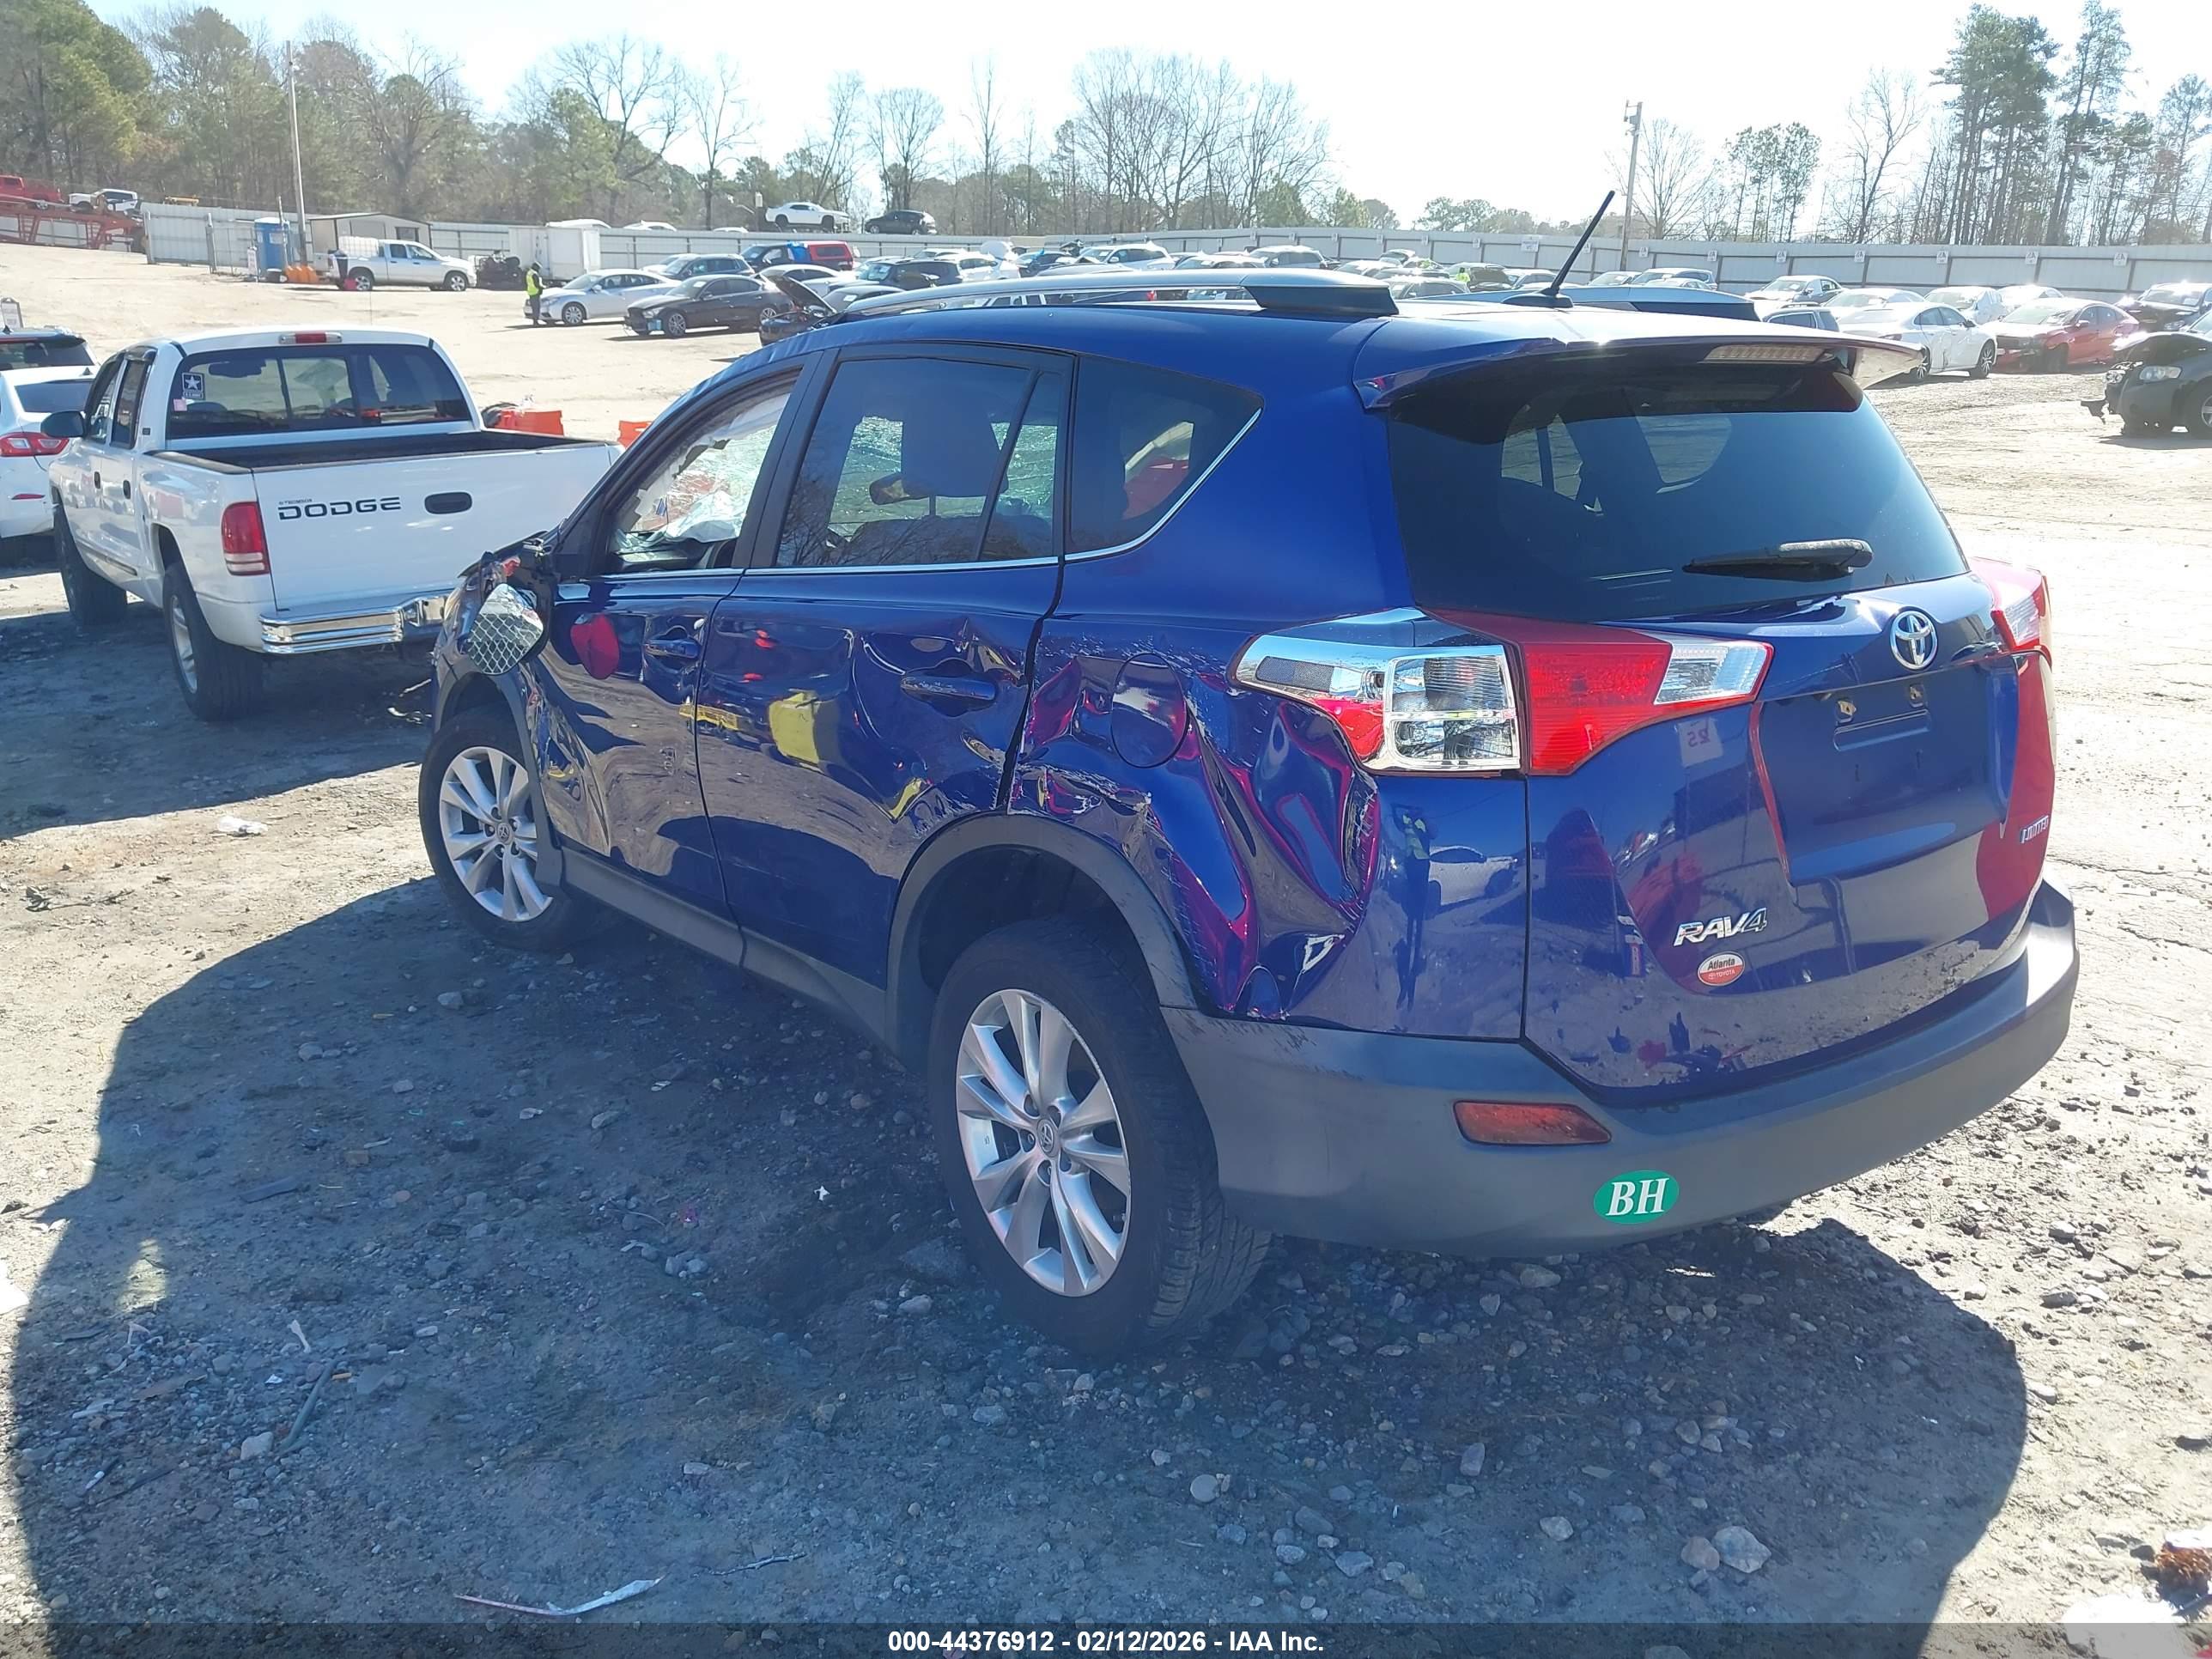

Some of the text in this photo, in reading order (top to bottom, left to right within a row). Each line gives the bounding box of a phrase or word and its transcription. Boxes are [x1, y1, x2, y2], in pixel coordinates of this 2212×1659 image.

[278, 497, 401, 520] DODGE
[1674, 908, 1767, 946] RAV4
[1708, 957, 1735, 970] Atlanta
[1605, 1177, 1670, 1216] BH
